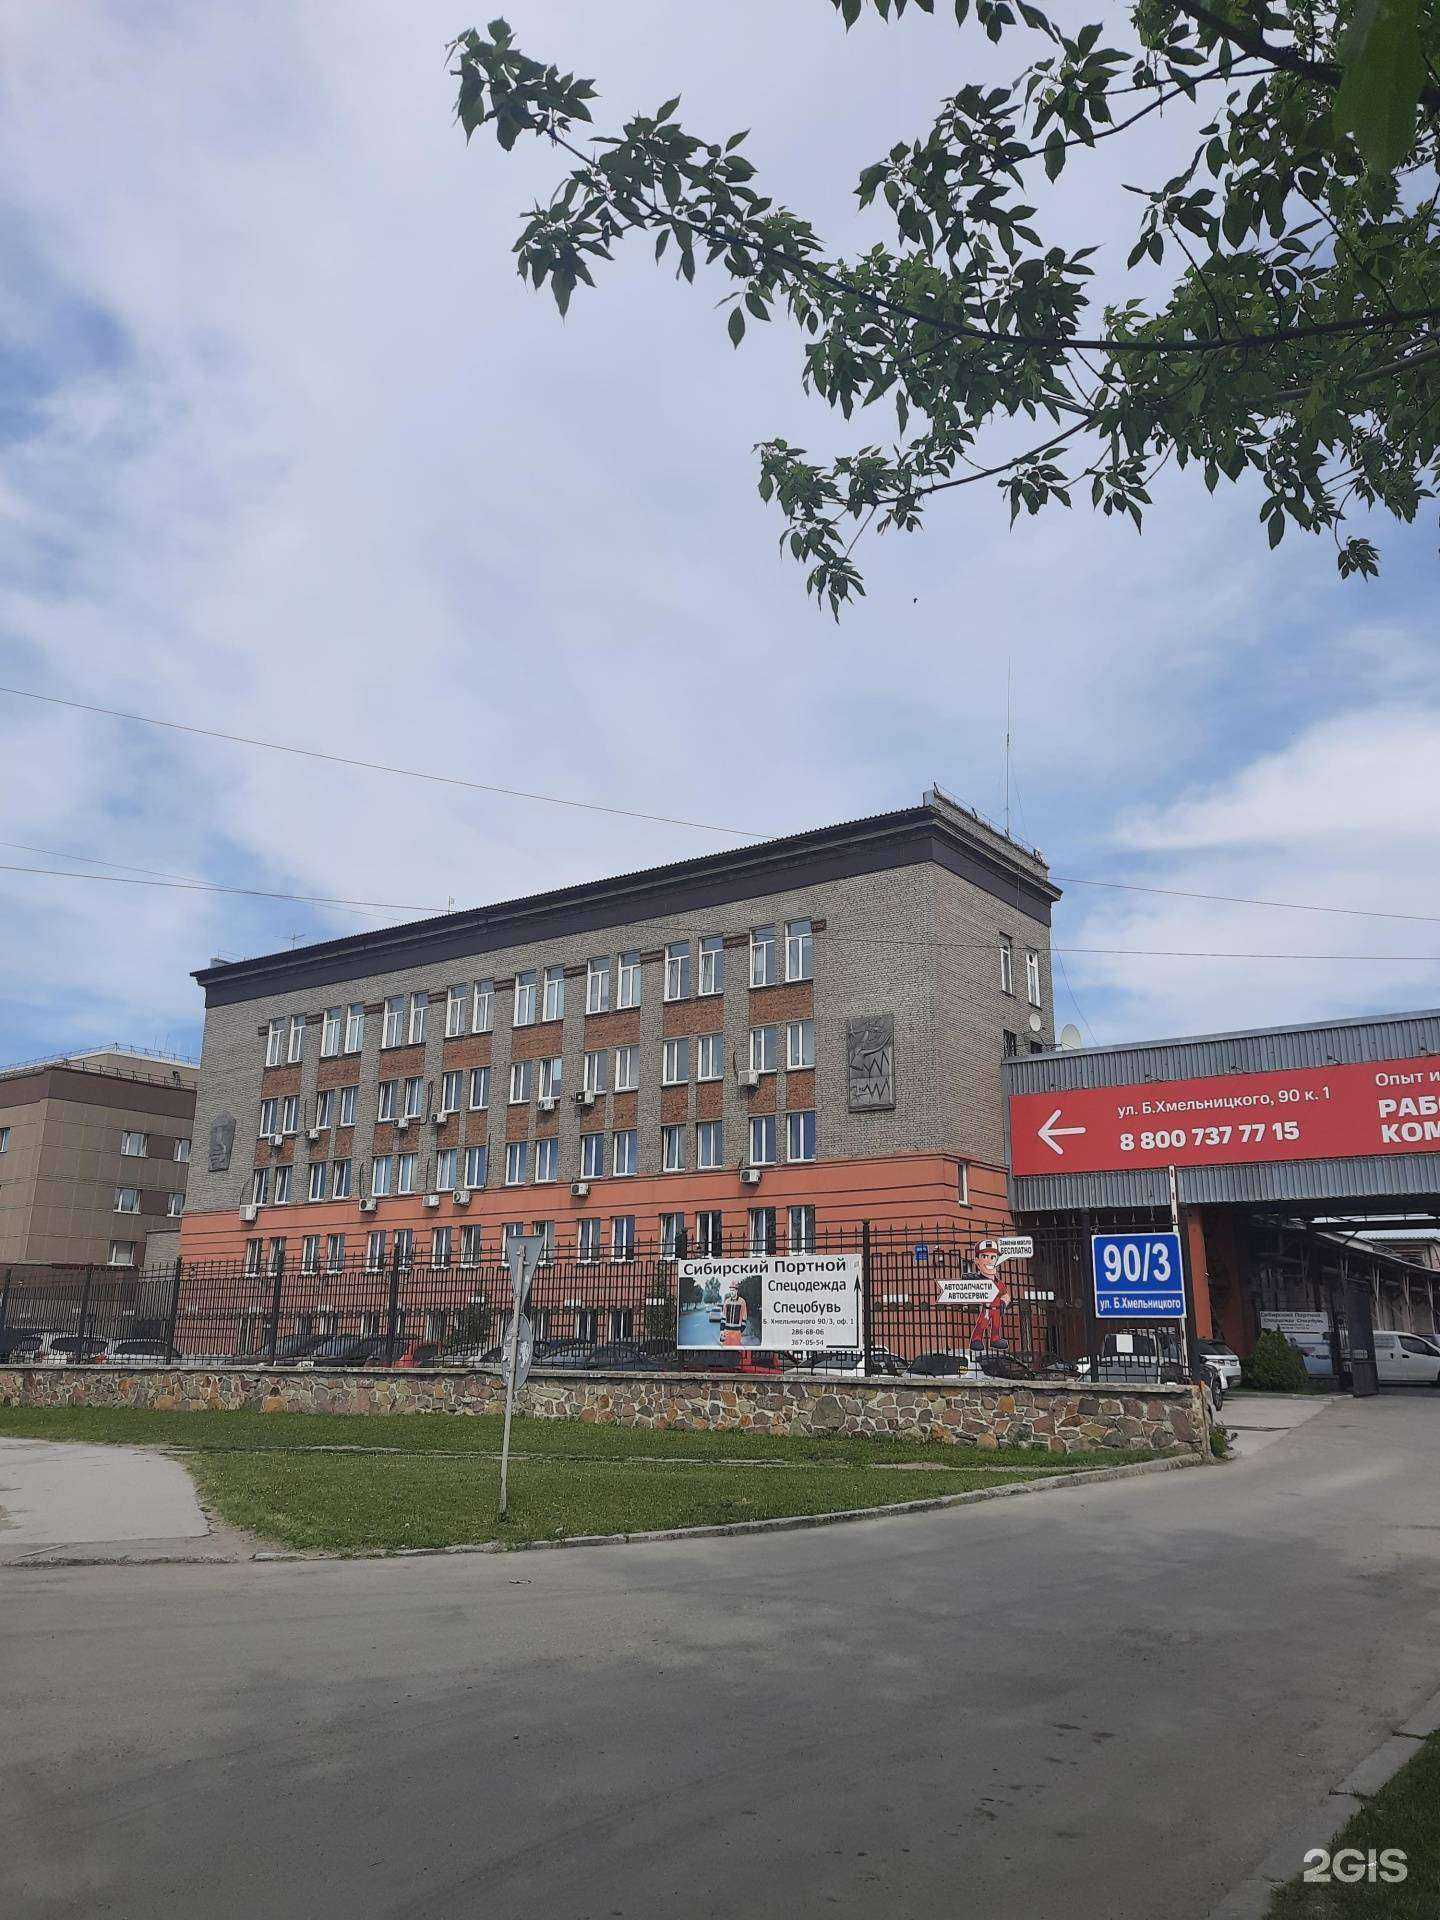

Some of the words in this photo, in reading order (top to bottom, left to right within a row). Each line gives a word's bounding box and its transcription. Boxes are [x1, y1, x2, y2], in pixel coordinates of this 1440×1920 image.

[1375, 1072, 1424, 1087] Опыт
[1117, 1105, 1138, 1119] ул.
[1142, 1093, 1275, 1115] Б.Хмельницкого,
[1278, 1089, 1300, 1103] 90
[1304, 1090, 1319, 1102] к.
[1322, 1086, 1331, 1100] 1
[1378, 1095, 1440, 1118] РАБ
[1119, 1133, 1135, 1151] 8
[1140, 1129, 1187, 1150] 800
[1191, 1125, 1233, 1146] 737
[1238, 1123, 1266, 1143] 77
[1272, 1121, 1300, 1140] 15
[1000, 1246, 1032, 1255] БЕСПЛАТНО
[683, 1259, 769, 1277] Сибирский
[774, 1257, 847, 1273] Портной
[1103, 1242, 1171, 1282] 90/3
[768, 1279, 847, 1293] Спецодежда
[944, 1283, 993, 1291] АВТОЗАПЧАСТИ
[948, 1292, 989, 1300] АВТОСЕРВИС
[773, 1301, 841, 1316] Спецобувь
[1100, 1300, 1112, 1311] ул.
[1113, 1297, 1181, 1311] Б.Хмельницкого
